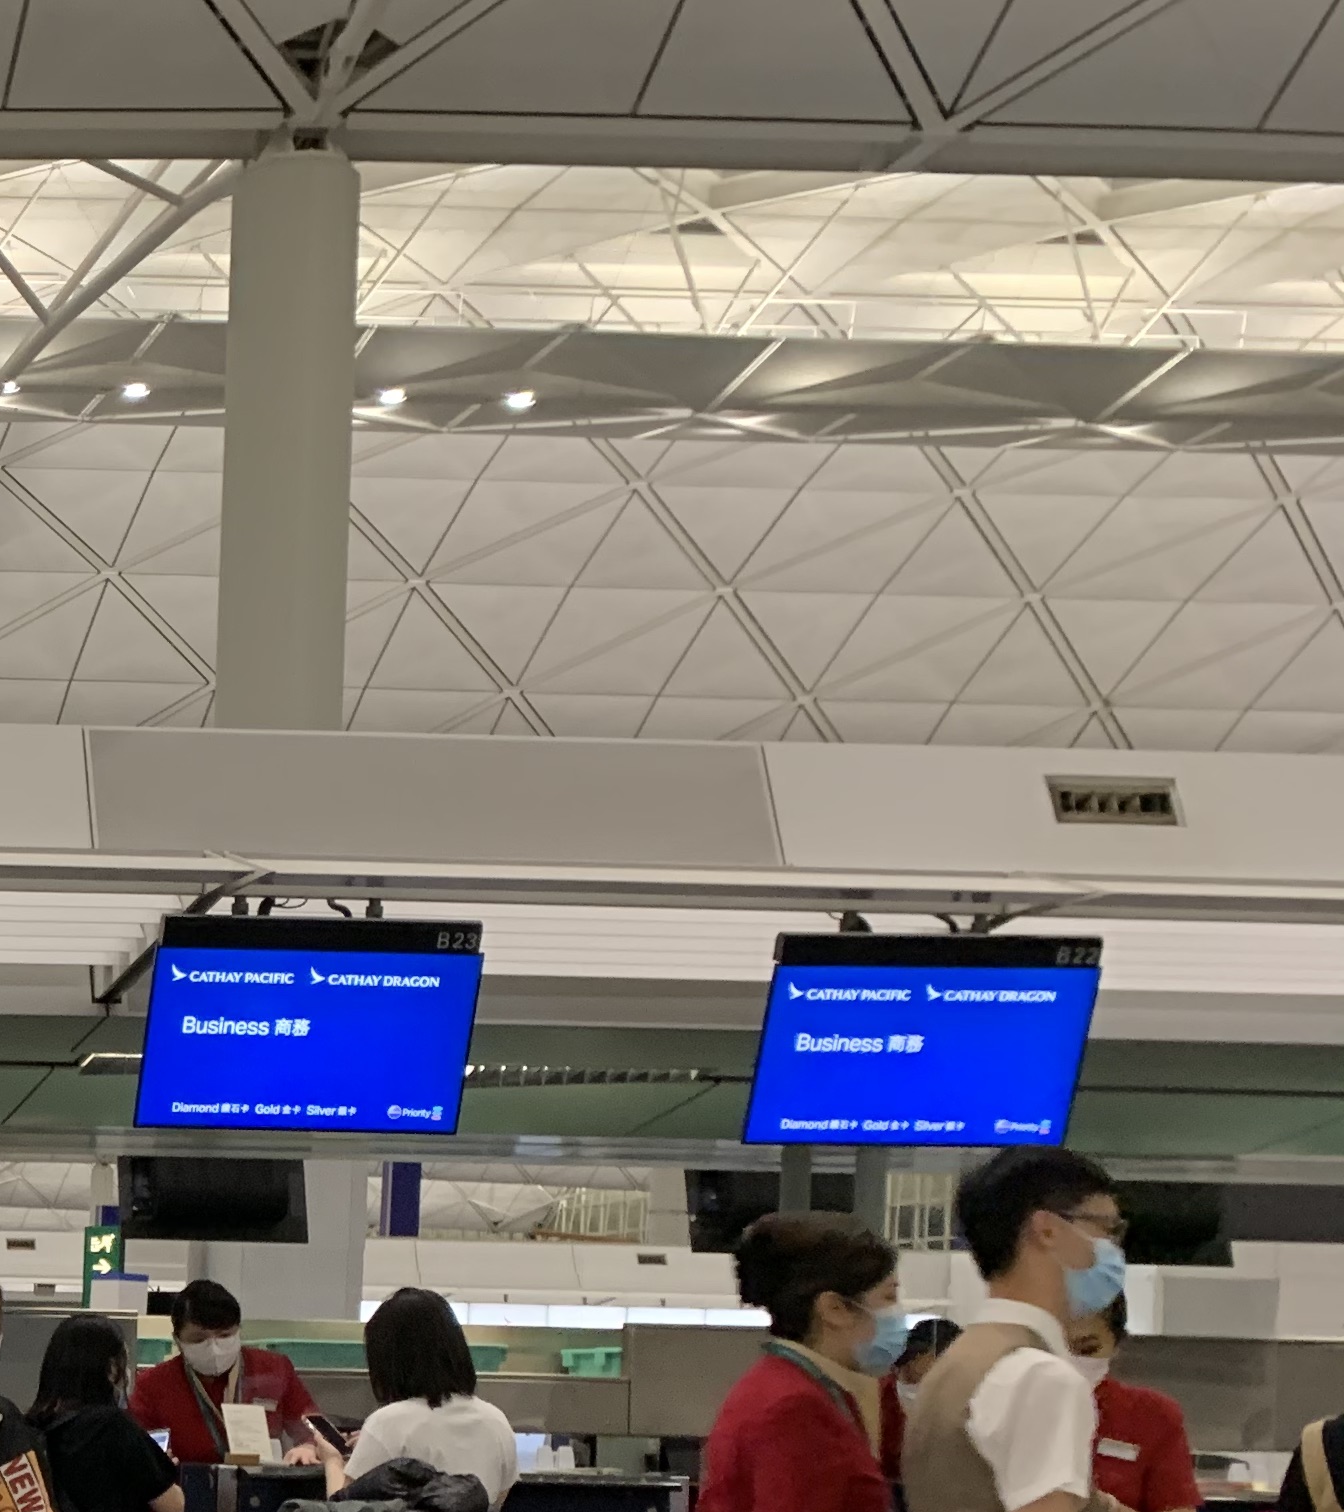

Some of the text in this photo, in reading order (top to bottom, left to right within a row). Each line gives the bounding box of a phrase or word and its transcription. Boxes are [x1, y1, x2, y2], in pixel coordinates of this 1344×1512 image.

[436, 931, 478, 950] B23
[189, 971, 295, 985] CATHAY PACIFIC
[327, 974, 440, 988] CATHAY DRAGON
[805, 987, 912, 1002] CATHAY PACIFIC
[943, 990, 1057, 1004] CATHAY DRAGON
[181, 1016, 311, 1037] Business 商務
[795, 1033, 884, 1053] Business
[171, 1101, 219, 1114] Diamond
[255, 1103, 280, 1115] Gold
[306, 1104, 336, 1116] Silver
[402, 1107, 432, 1119] Priority
[779, 1118, 828, 1130] Diamond
[862, 1119, 889, 1131] Gold
[914, 1119, 944, 1132] Silver
